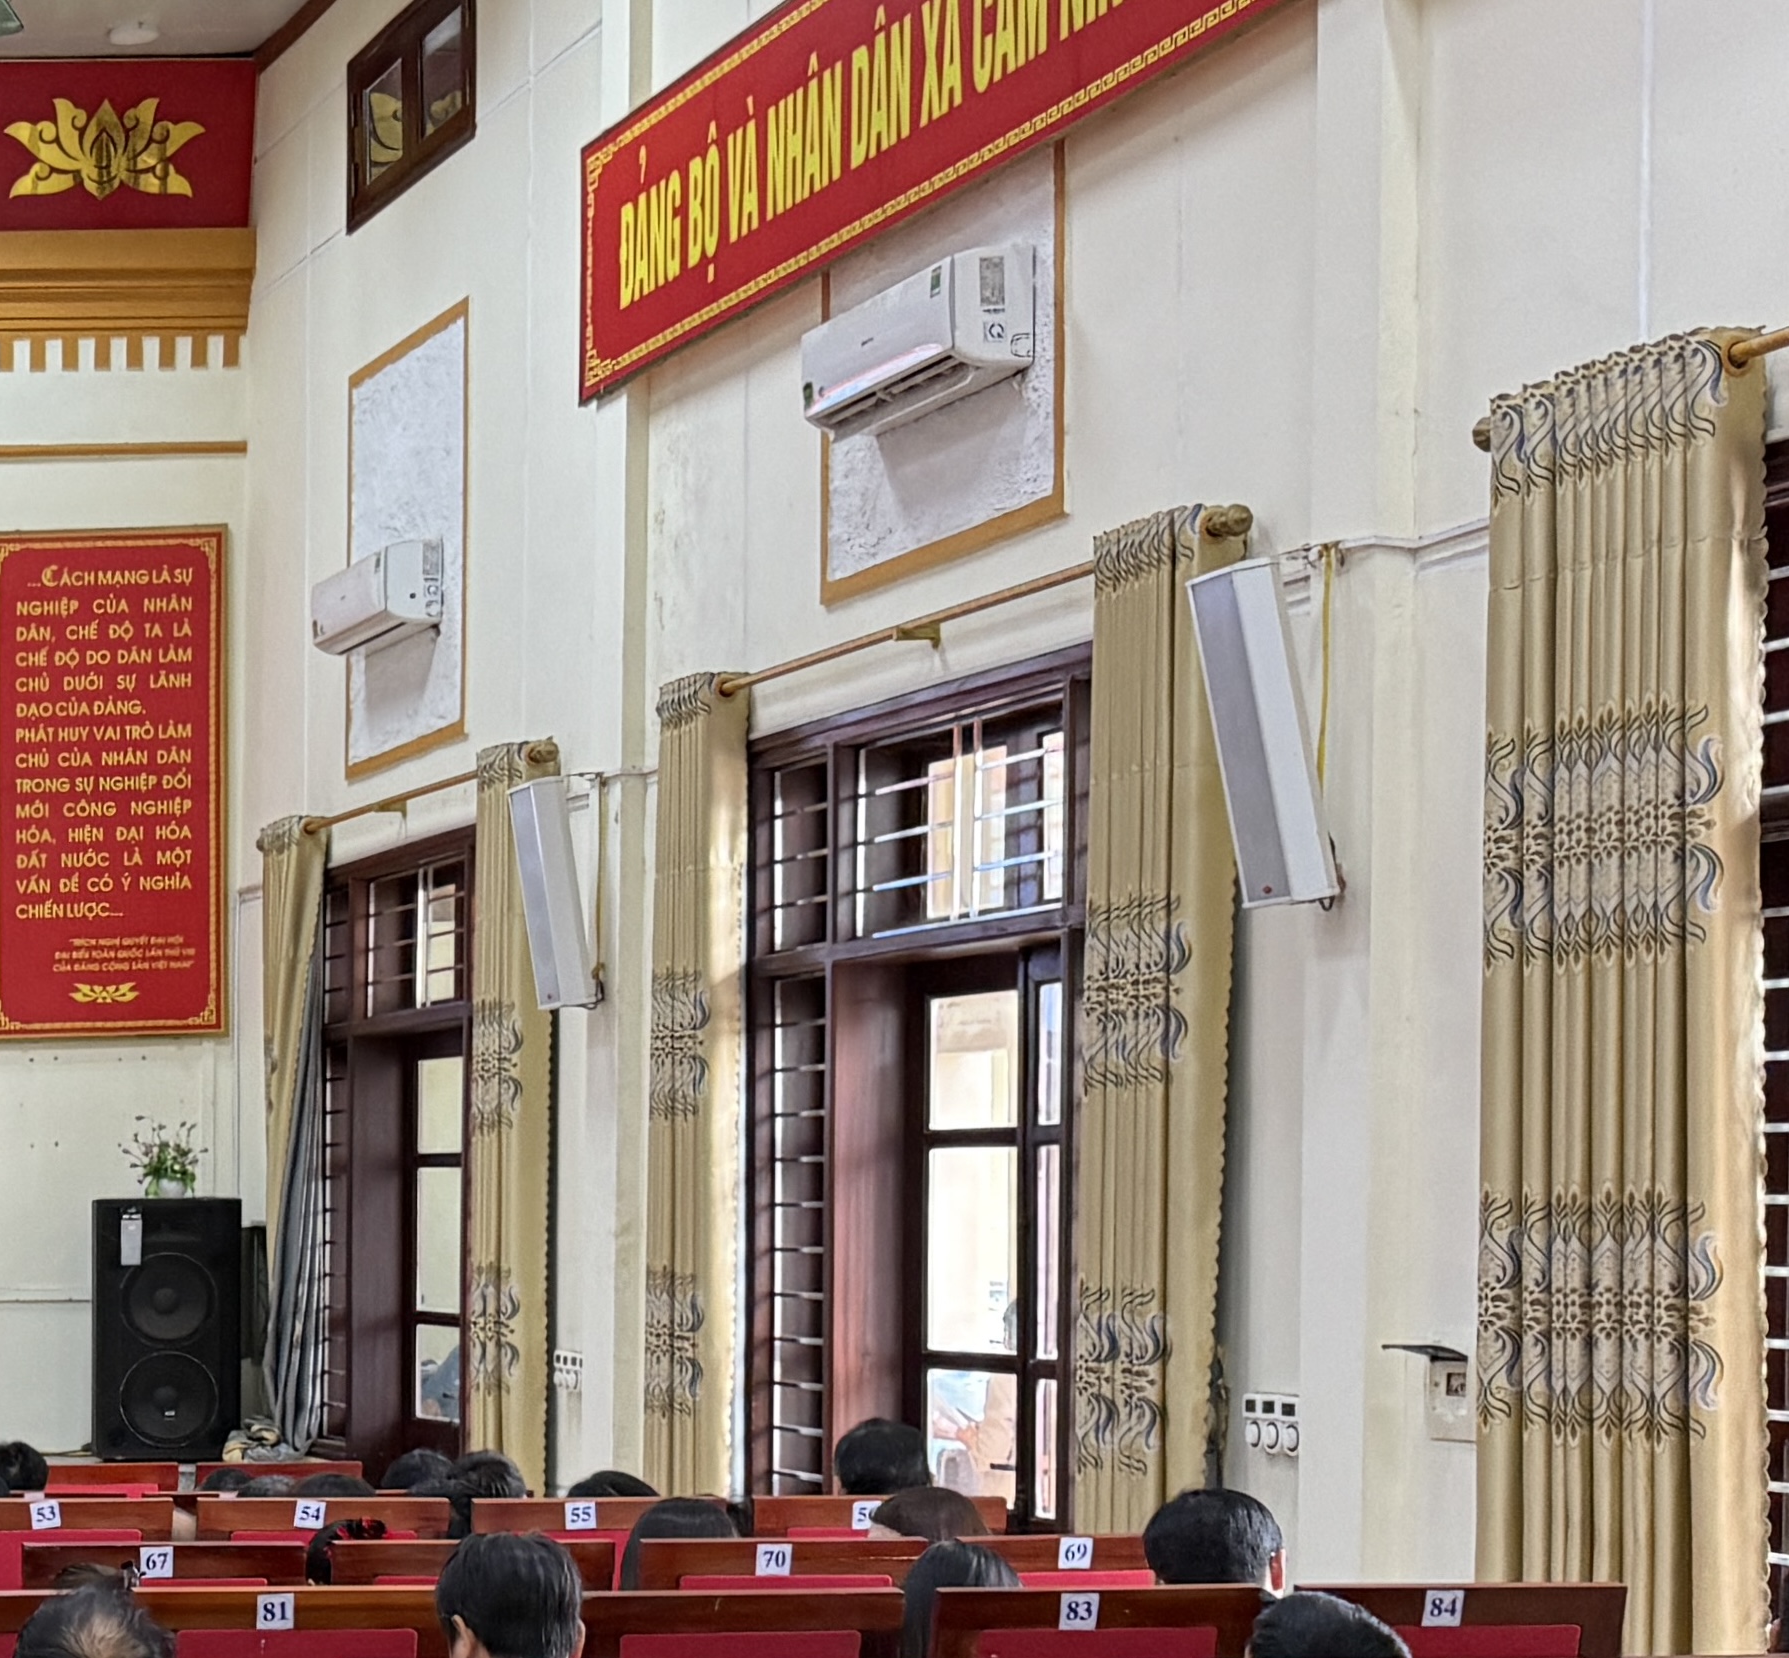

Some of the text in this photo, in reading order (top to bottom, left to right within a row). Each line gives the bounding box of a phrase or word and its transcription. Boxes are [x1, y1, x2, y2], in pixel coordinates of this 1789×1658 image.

[619, 144, 682, 311] ĐẢNG
[687, 119, 721, 284] BỘ
[727, 94, 760, 245] VÀ
[766, 50, 843, 222] NHÂN
[850, 3, 912, 171] DÂN
[98, 570, 149, 587] MẠNG
[174, 568, 192, 585] SỰ
[17, 594, 192, 617] NGHIỆP CỦA NHÂN
[66, 620, 98, 640] CHẾ
[109, 621, 133, 641] ĐỘ
[145, 623, 162, 637] TA
[16, 644, 192, 668] CHẾ ĐỘ DO DÂN LÀM
[16, 671, 191, 692] CHỦ DƯỚI SỰ LÃNH
[16, 696, 145, 720] ĐẠO CỦA ĐẢNG.
[16, 720, 191, 742] PHÁT HUY VAI TRÒ LÀM
[36, 1505, 56, 1523] 53
[299, 1505, 321, 1521] 54
[570, 1506, 592, 1524] 55
[145, 1552, 168, 1571] 67
[763, 1550, 786, 1568] 70
[1064, 1544, 1088, 1561] 69
[263, 1601, 287, 1622] 81
[1066, 1600, 1093, 1621] 83
[1429, 1597, 1457, 1617] 84
